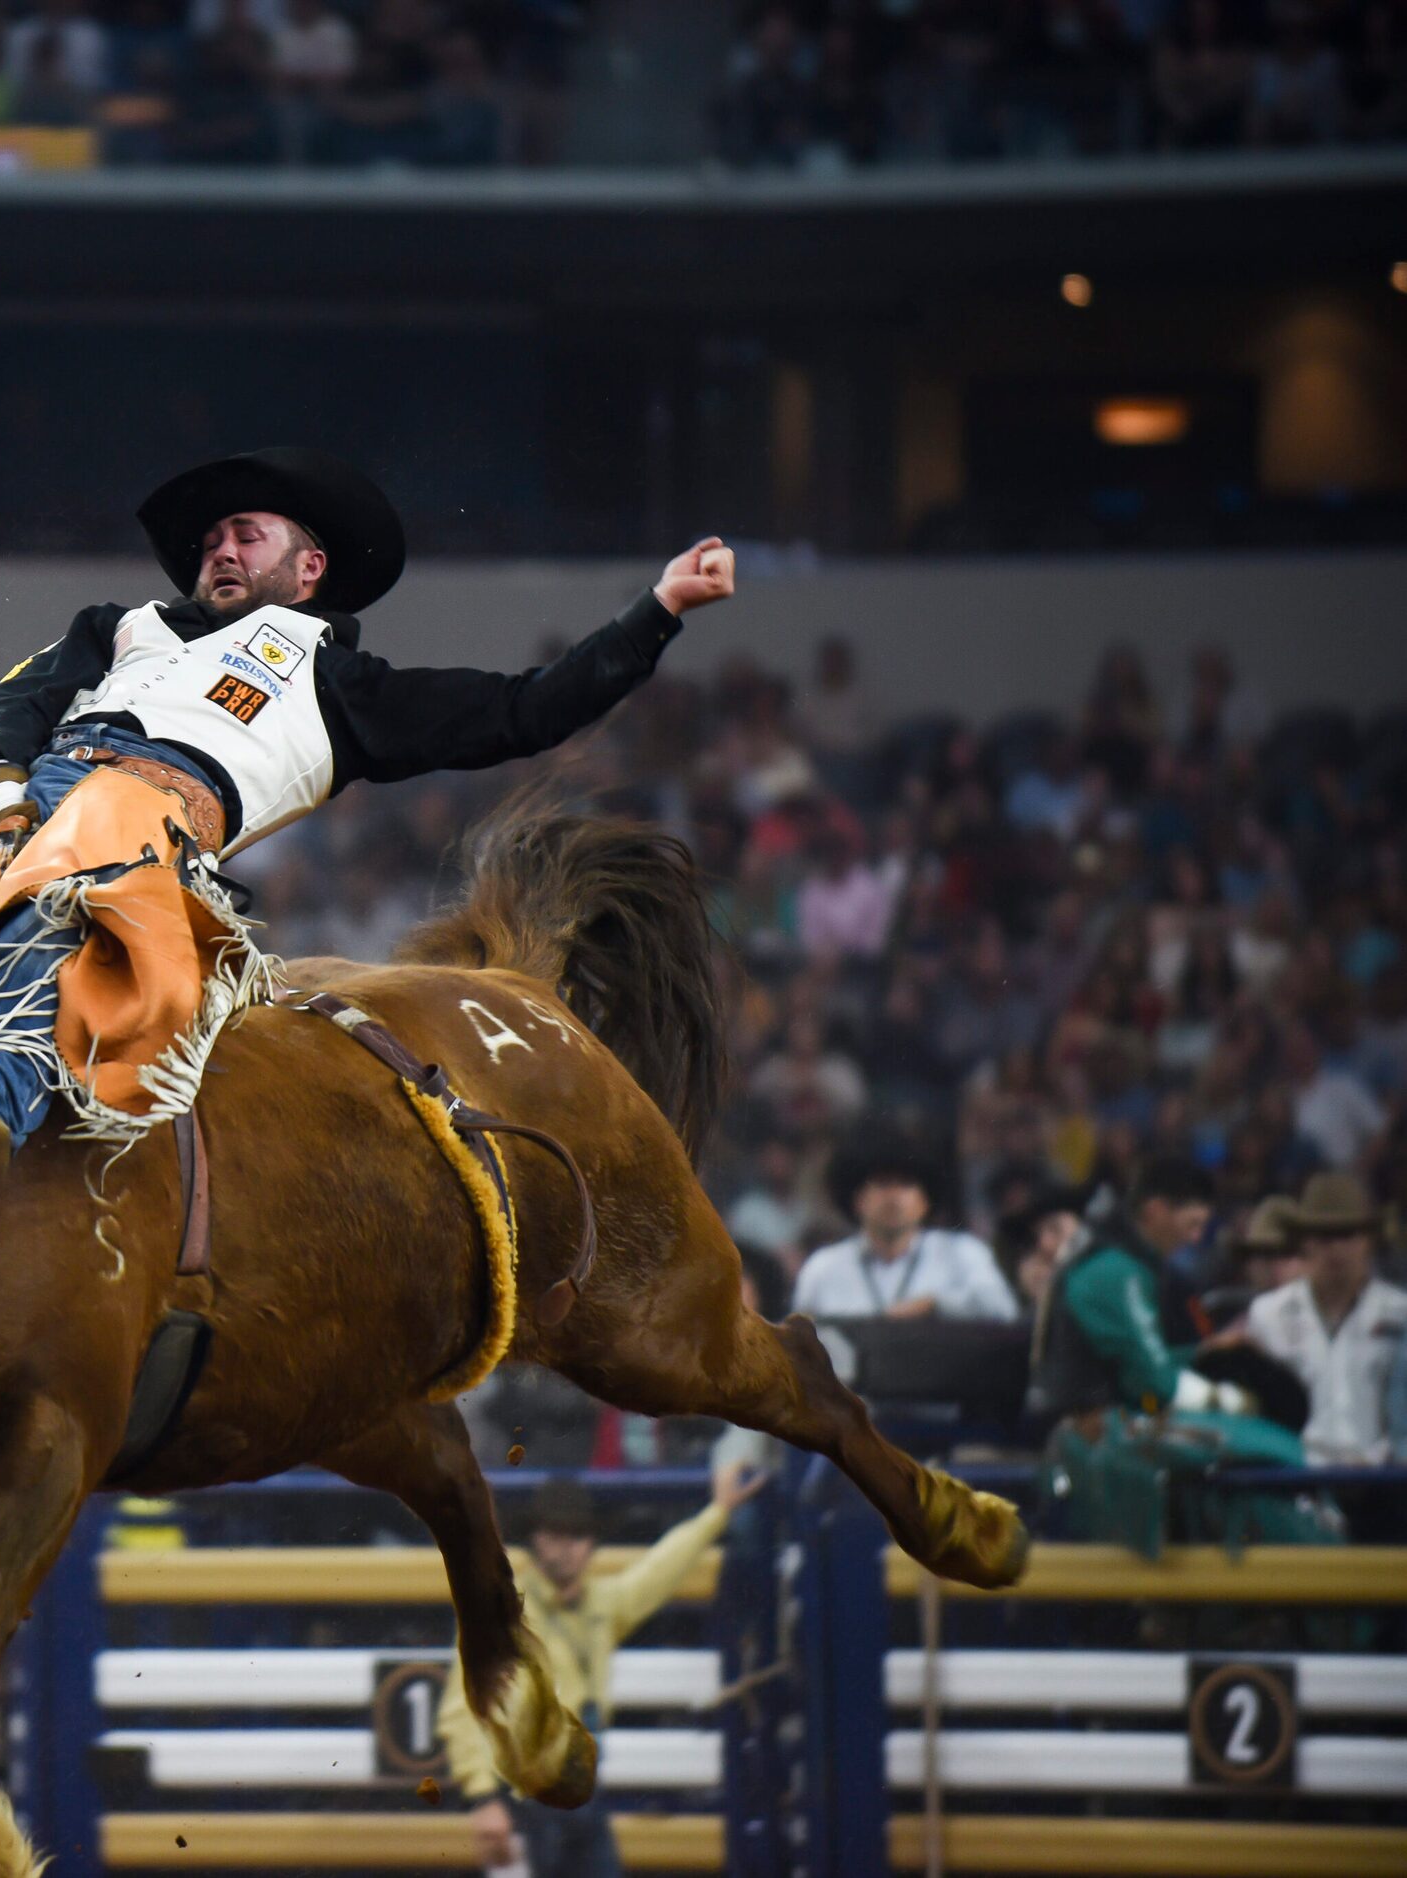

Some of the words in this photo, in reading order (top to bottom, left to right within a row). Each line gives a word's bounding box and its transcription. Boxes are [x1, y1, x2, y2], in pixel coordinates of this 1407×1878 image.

[262, 632, 299, 656] ARIAT
[220, 652, 283, 701] RESISTOL
[223, 678, 265, 708] PWR
[210, 688, 253, 721] PRO
[404, 1681, 430, 1753] 1
[1224, 1684, 1260, 1761] 2
